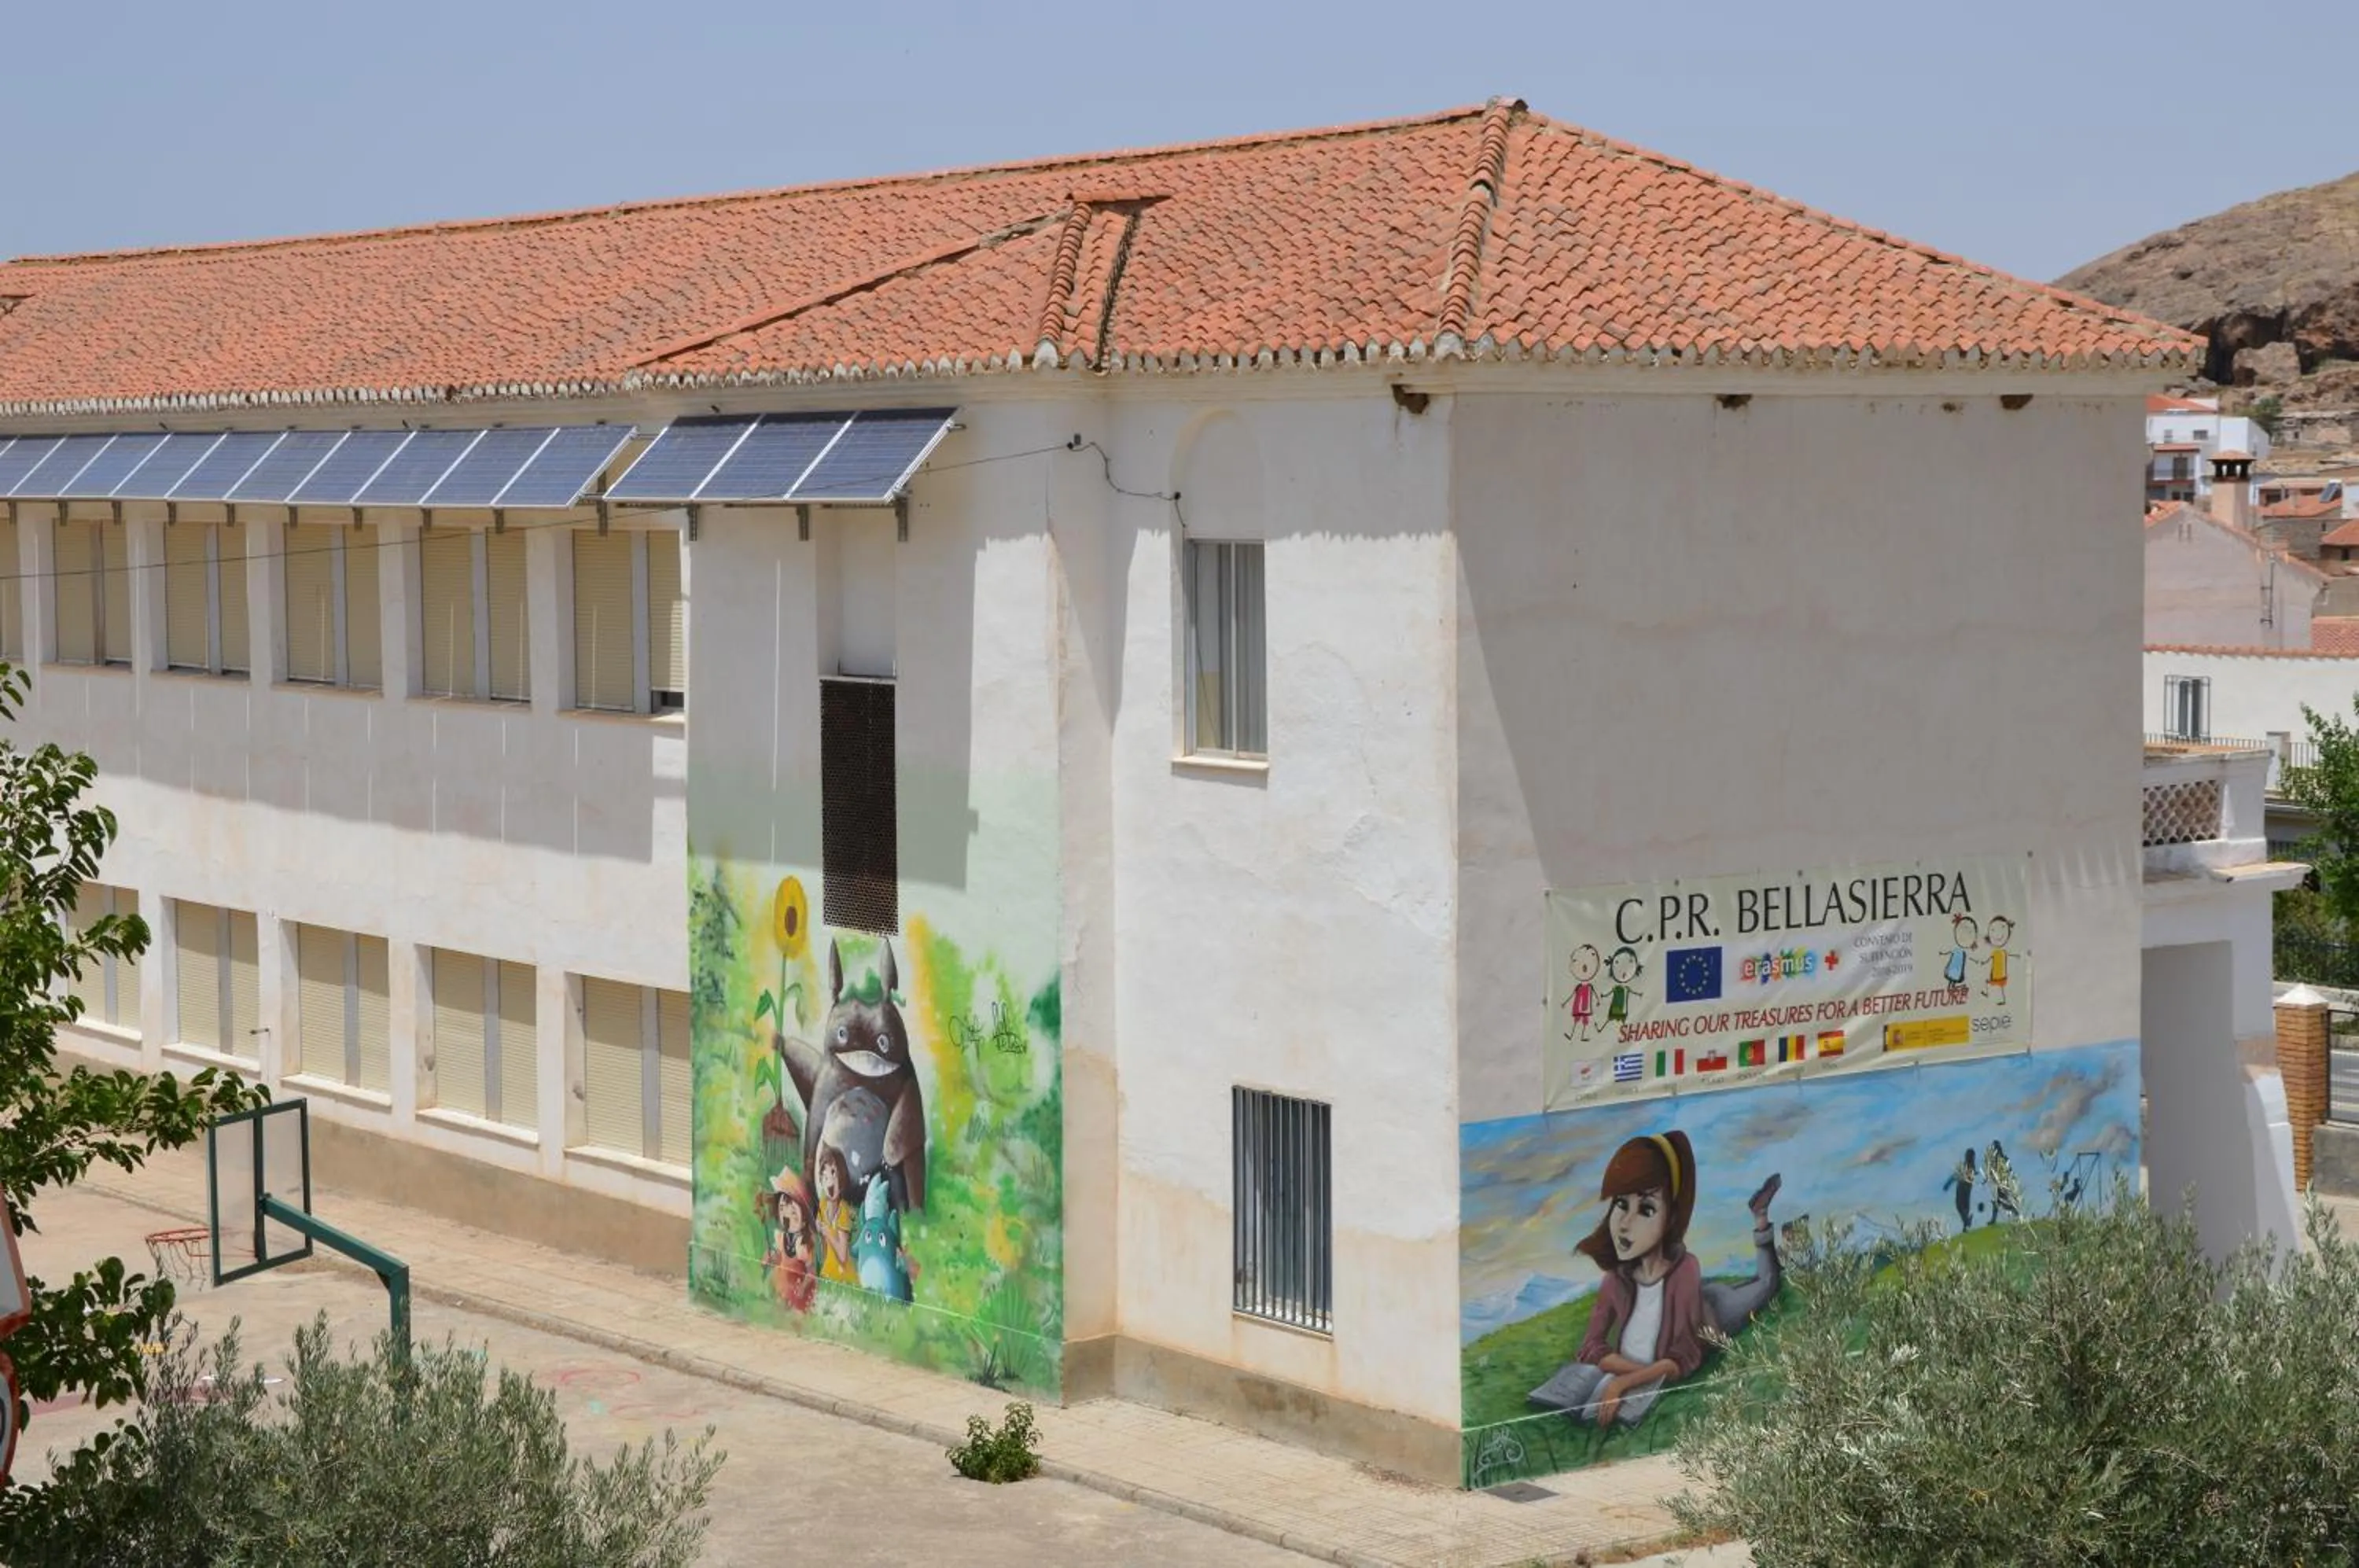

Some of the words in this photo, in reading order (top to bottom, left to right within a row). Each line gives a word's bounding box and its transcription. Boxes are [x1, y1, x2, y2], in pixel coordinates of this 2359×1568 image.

[1616, 893, 1720, 944] C.P.R.
[1738, 871, 1971, 933] BELLASIERRA
[1617, 1017, 1689, 1043] SHARING
[1693, 1013, 1729, 1035] OUR
[1733, 1004, 1812, 1030] TREASURES
[1816, 999, 1846, 1021] FOR
[1846, 999, 1858, 1017] A
[1862, 993, 1912, 1016] BETTER
[1914, 986, 1969, 1010] FUTURE
